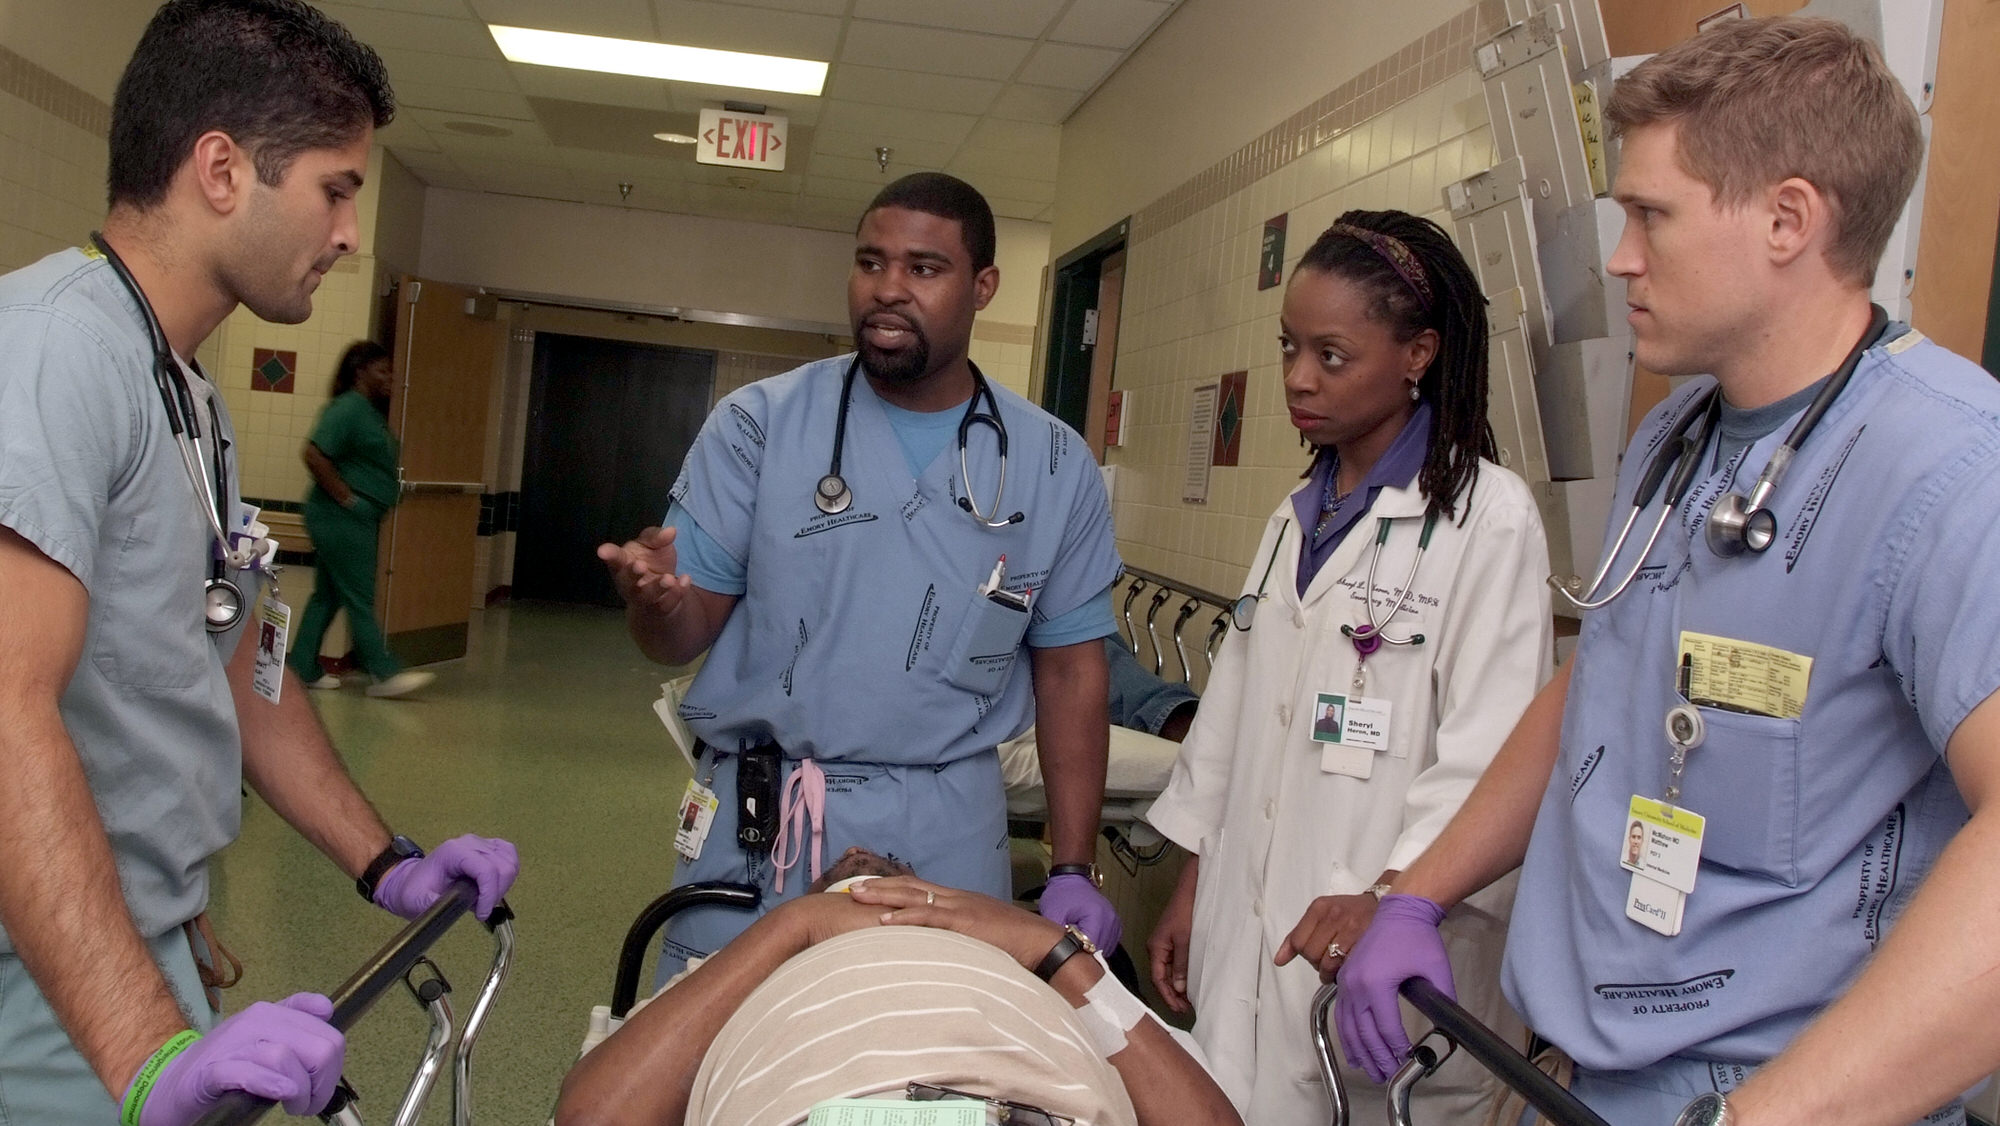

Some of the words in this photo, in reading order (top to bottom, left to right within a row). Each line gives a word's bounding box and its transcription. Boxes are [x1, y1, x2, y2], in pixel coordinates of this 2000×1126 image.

[717, 118, 774, 162] EXIT
[801, 523, 825, 534] EMORY
[827, 513, 872, 526] HEALTHCARE
[1785, 517, 1810, 560] EMORY
[1010, 571, 1039, 581] PROPERTY
[924, 592, 936, 617] EMORY
[911, 618, 928, 665] HEALTHCARE
[1347, 728, 1369, 736] Heron,
[1348, 720, 1374, 729] Sheryl
[1852, 860, 1872, 919] PROPERTY
[1865, 843, 1874, 857] OF
[1864, 898, 1879, 940] EMORY
[1876, 815, 1898, 895] HEALTHCARE
[1602, 988, 1678, 1000] HEALTHCARE
[1682, 976, 1725, 995] EMORY
[1633, 1005, 1648, 1014] OF
[1652, 1000, 1710, 1014] PROPERTY
[146, 1046, 178, 1081] Emergency
